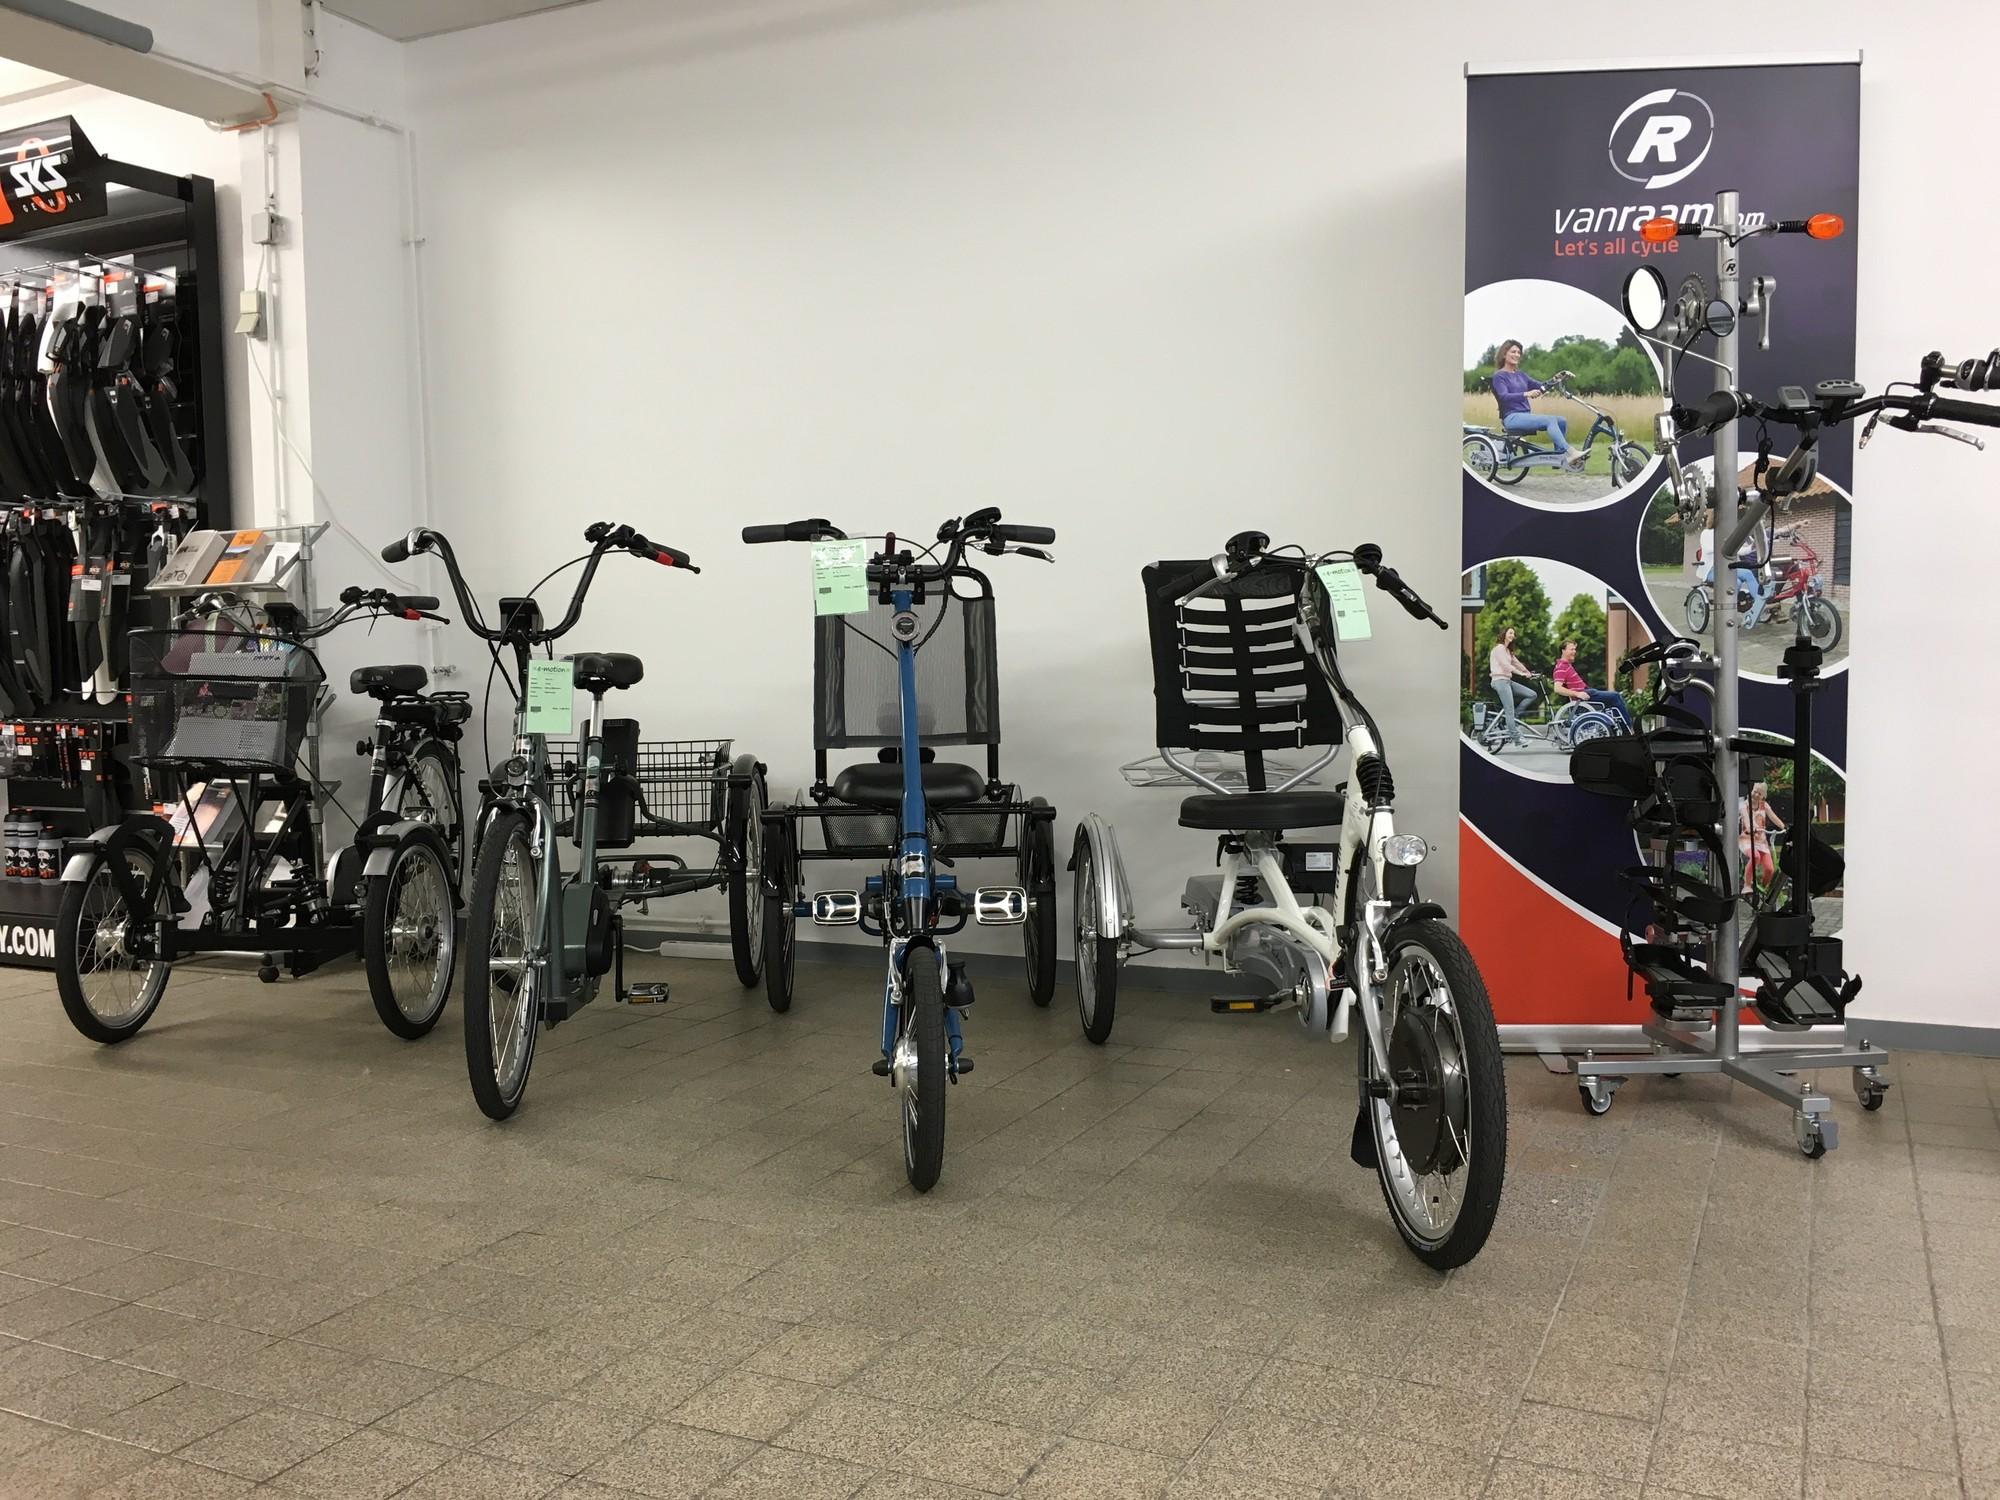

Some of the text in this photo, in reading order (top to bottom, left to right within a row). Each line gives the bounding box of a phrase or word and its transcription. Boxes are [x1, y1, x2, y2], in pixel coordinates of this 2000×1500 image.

[1627, 115, 1692, 163] R
[10, 155, 67, 198] SKS
[1554, 238, 1679, 257] Let's all cycle
